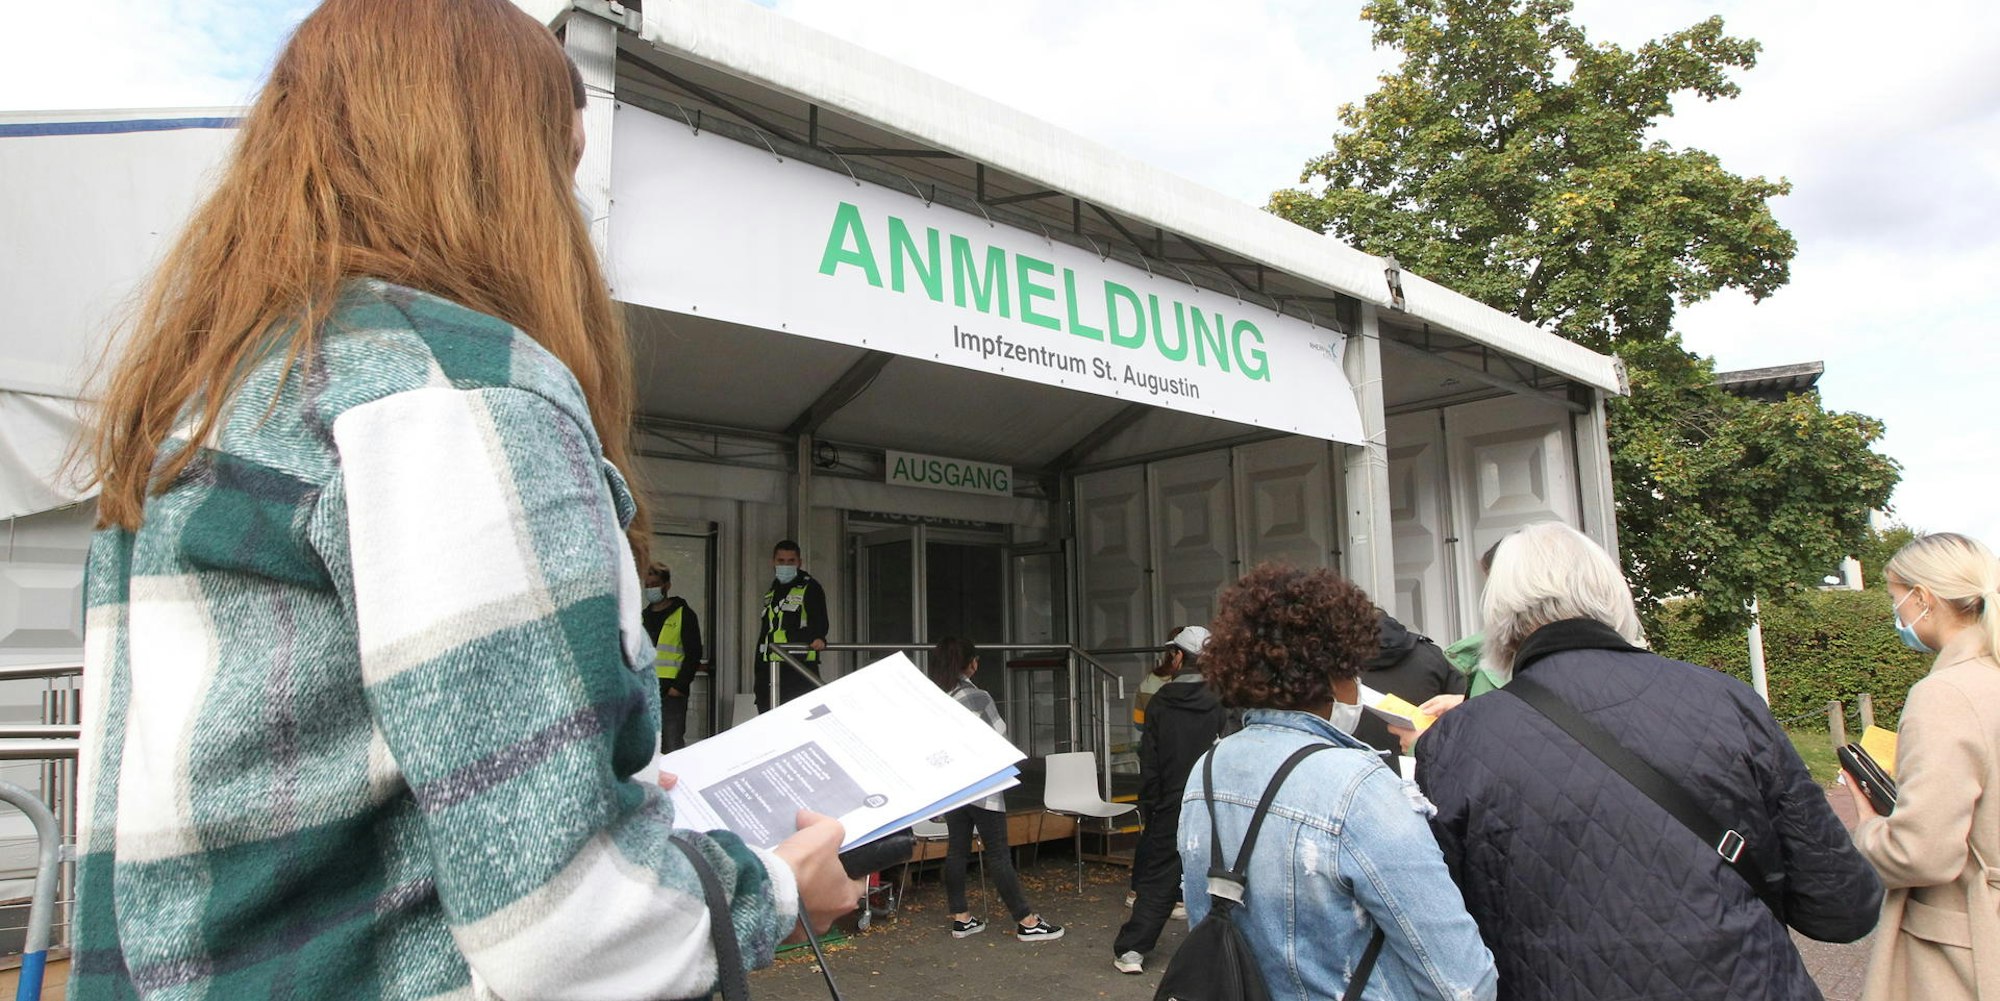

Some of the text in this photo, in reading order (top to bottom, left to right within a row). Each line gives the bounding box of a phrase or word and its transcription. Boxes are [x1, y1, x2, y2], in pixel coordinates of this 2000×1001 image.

[819, 202, 1271, 382] ANMELDUNG
[953, 325, 1200, 399] Impfzentrum St. Augustin
[893, 457, 1008, 492] AUSGANG
